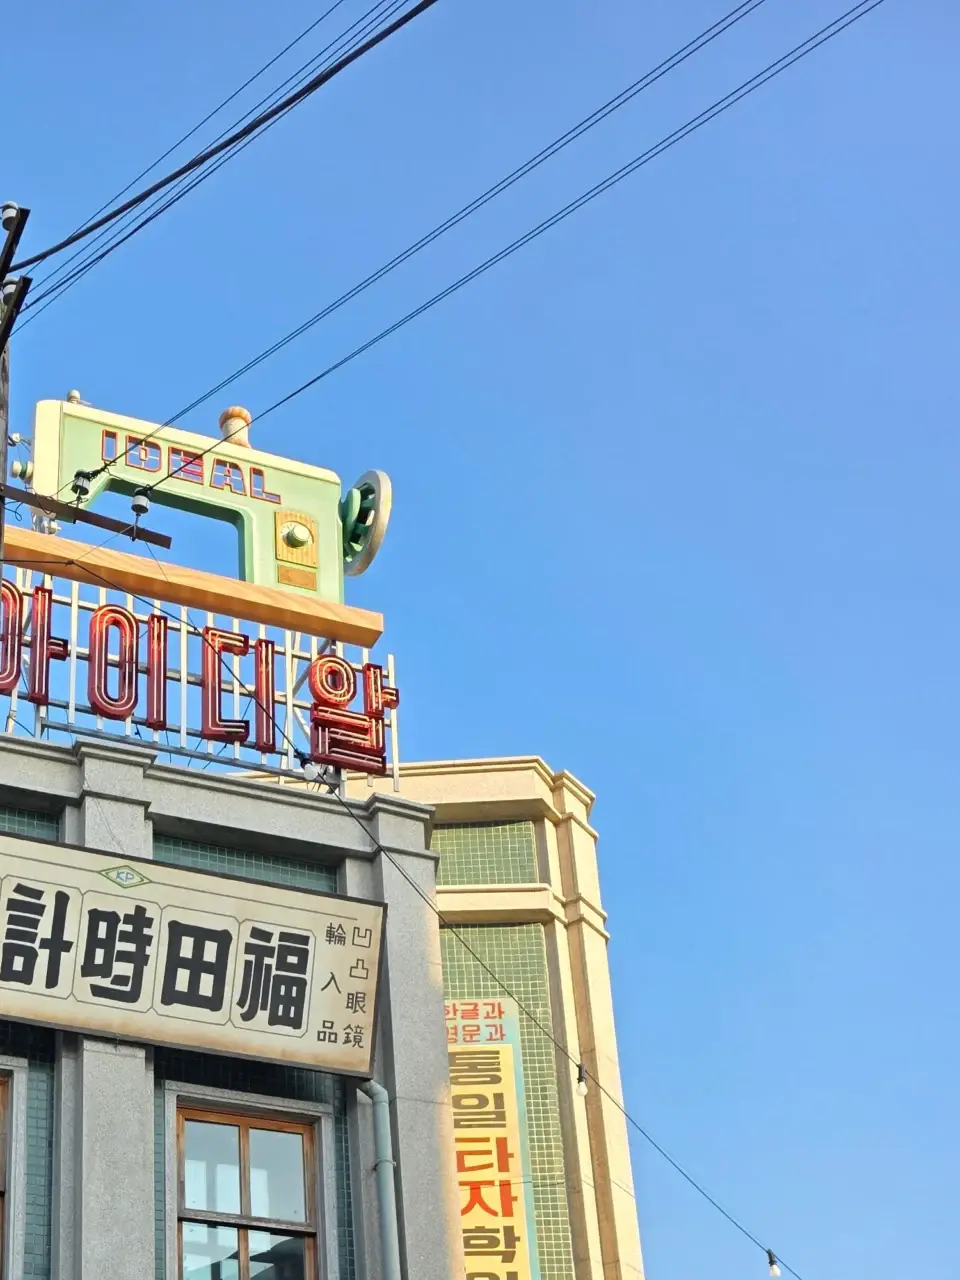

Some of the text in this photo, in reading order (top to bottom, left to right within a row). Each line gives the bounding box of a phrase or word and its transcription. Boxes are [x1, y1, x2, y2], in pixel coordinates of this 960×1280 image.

[101, 428, 282, 504] IDEAL
[342, 926, 373, 1049] 凹凸眼鏡
